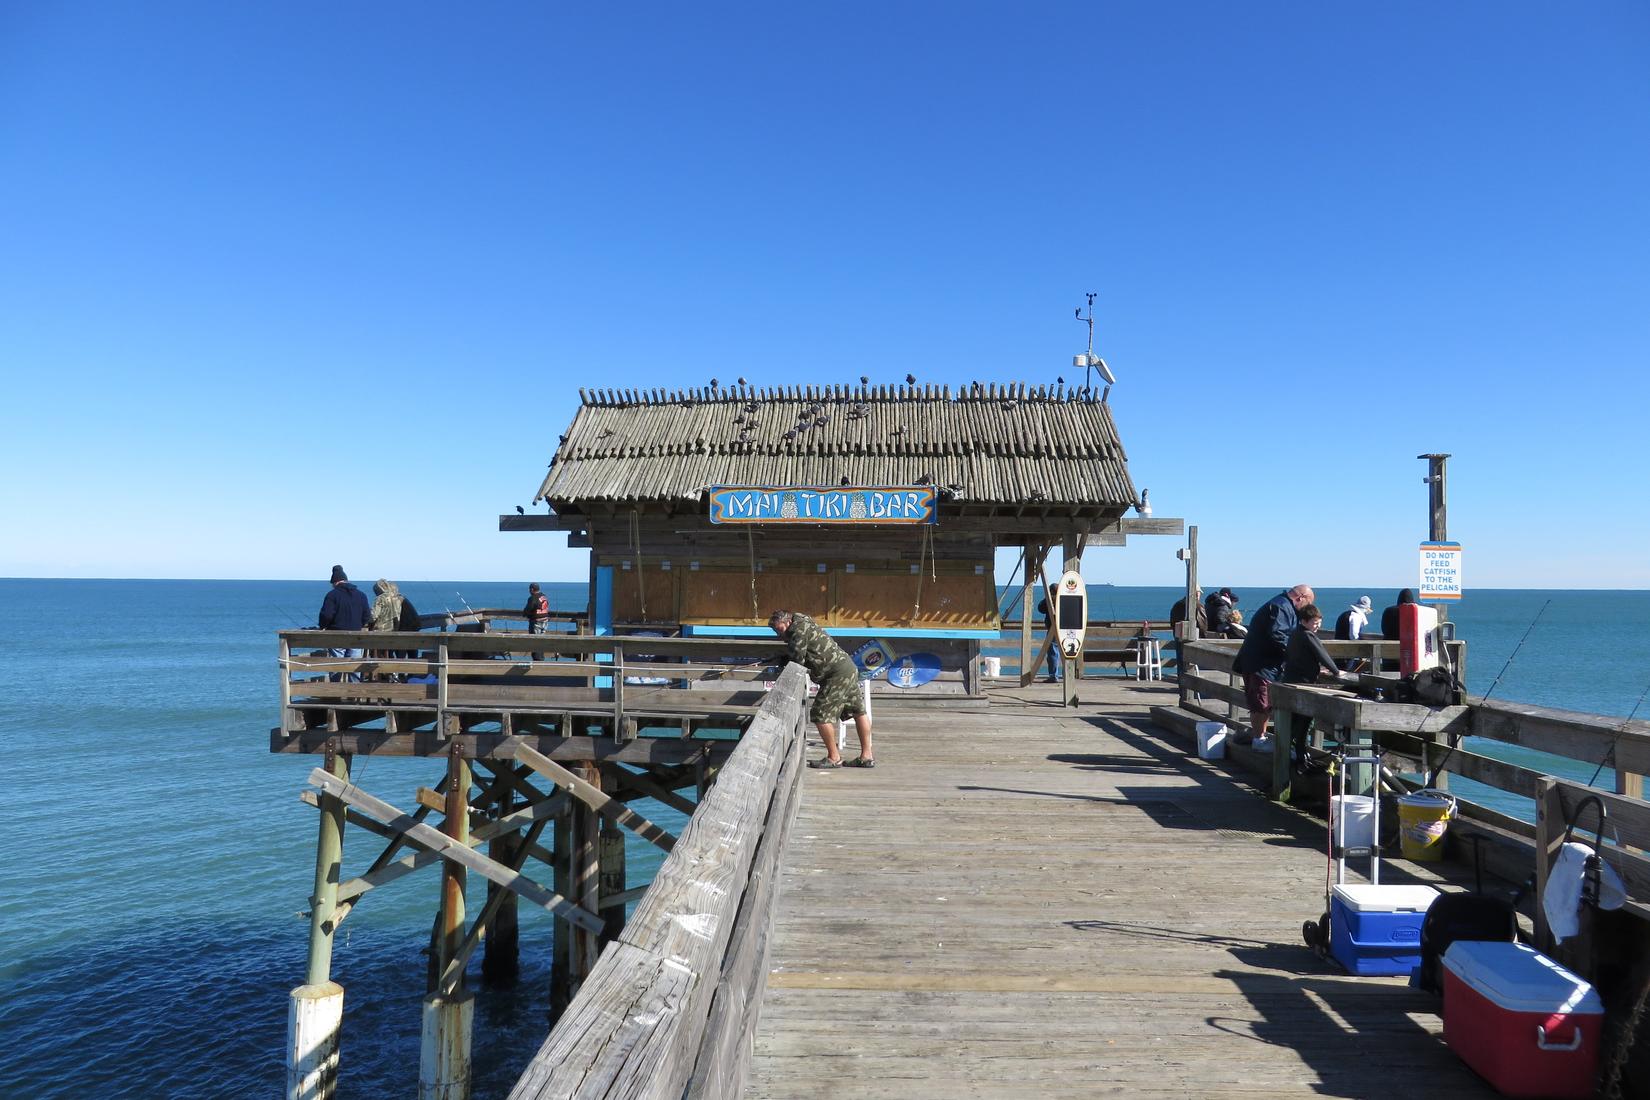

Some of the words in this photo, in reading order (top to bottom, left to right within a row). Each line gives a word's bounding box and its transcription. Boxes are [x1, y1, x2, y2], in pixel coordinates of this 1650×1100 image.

[729, 493, 778, 517] MAI
[801, 493, 848, 517] TIKI
[870, 492, 920, 518] BAR
